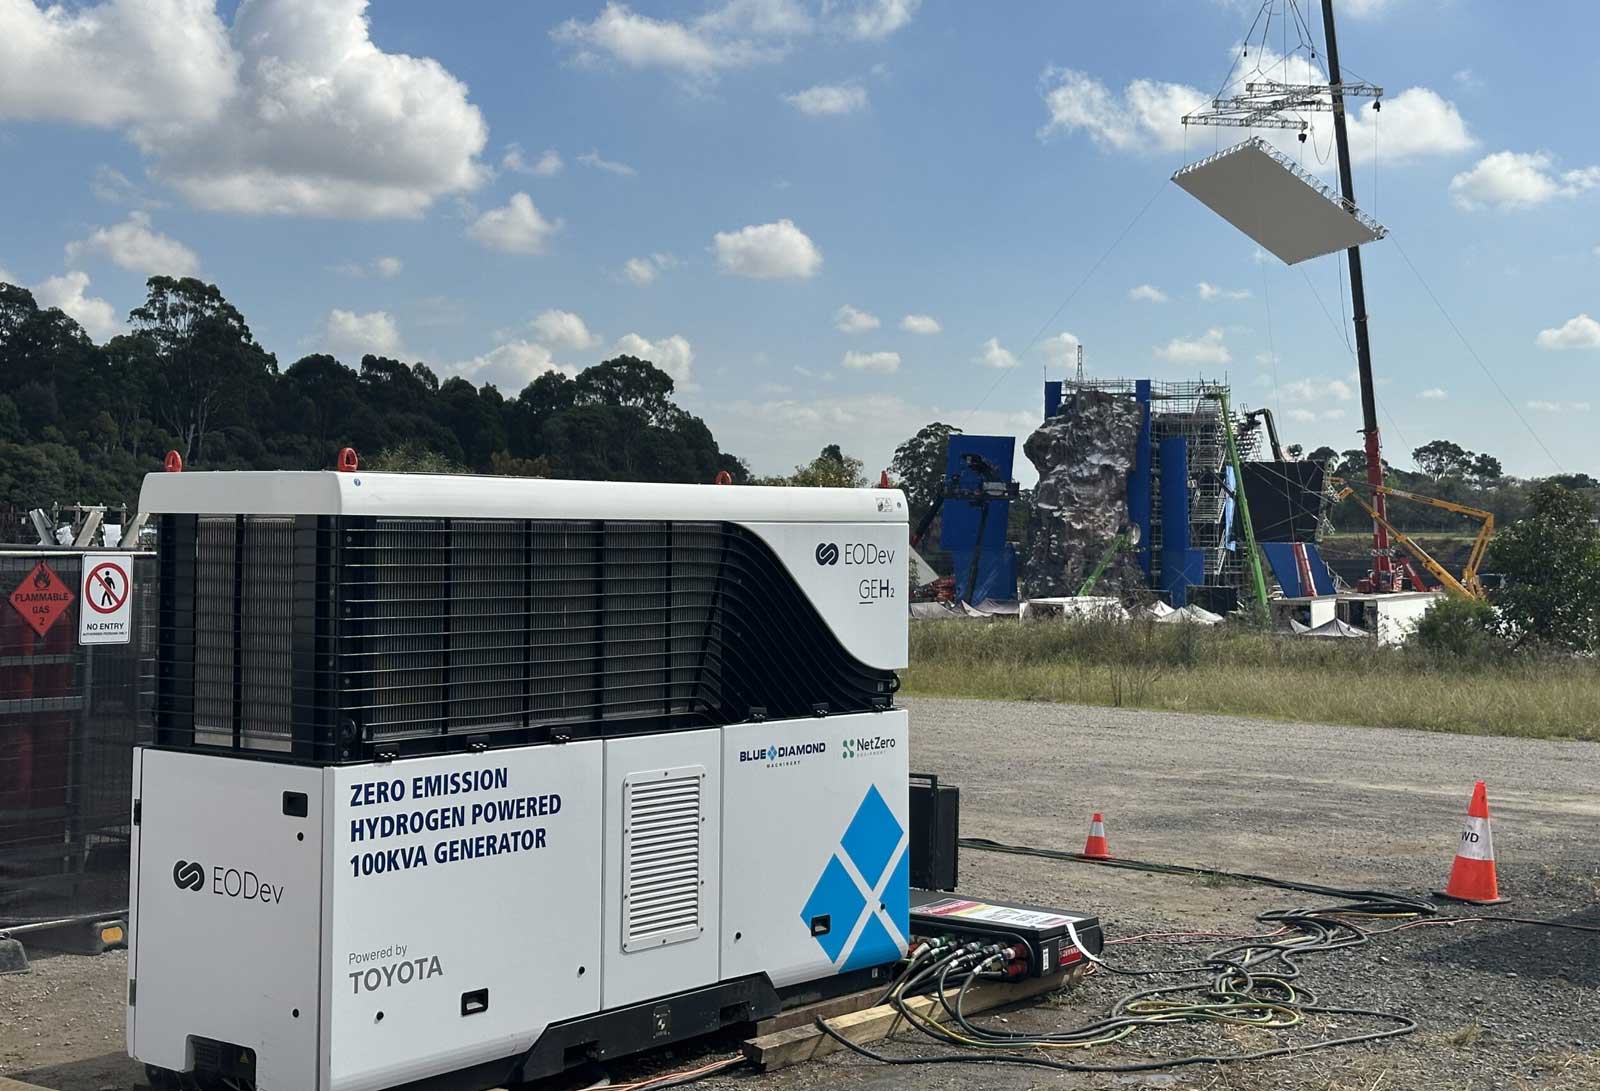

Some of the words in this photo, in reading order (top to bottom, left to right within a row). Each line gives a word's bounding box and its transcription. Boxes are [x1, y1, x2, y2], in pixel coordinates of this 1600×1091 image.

[844, 543, 895, 565] EODev
[15, 592, 69, 602] FLAMMABLE
[32, 606, 50, 614] GAS
[39, 616, 45, 626] 2
[86, 623, 98, 631] NO
[99, 622, 125, 631] ENTRY
[739, 749, 767, 762] BLUE
[777, 742, 826, 758] DIAMOND
[856, 736, 896, 751] NetZero
[766, 760, 801, 768] MACHINERY
[349, 780, 405, 807] ZERO
[412, 767, 508, 798] EMISSION
[350, 806, 465, 842] HYDROGEN
[471, 794, 562, 825] POWERED
[350, 845, 428, 877] 100KVA
[434, 828, 546, 864] GENERATOR
[213, 866, 284, 904] EODev
[348, 945, 393, 965] Powered
[395, 943, 408, 958] by
[348, 955, 444, 995] TOYOTA
